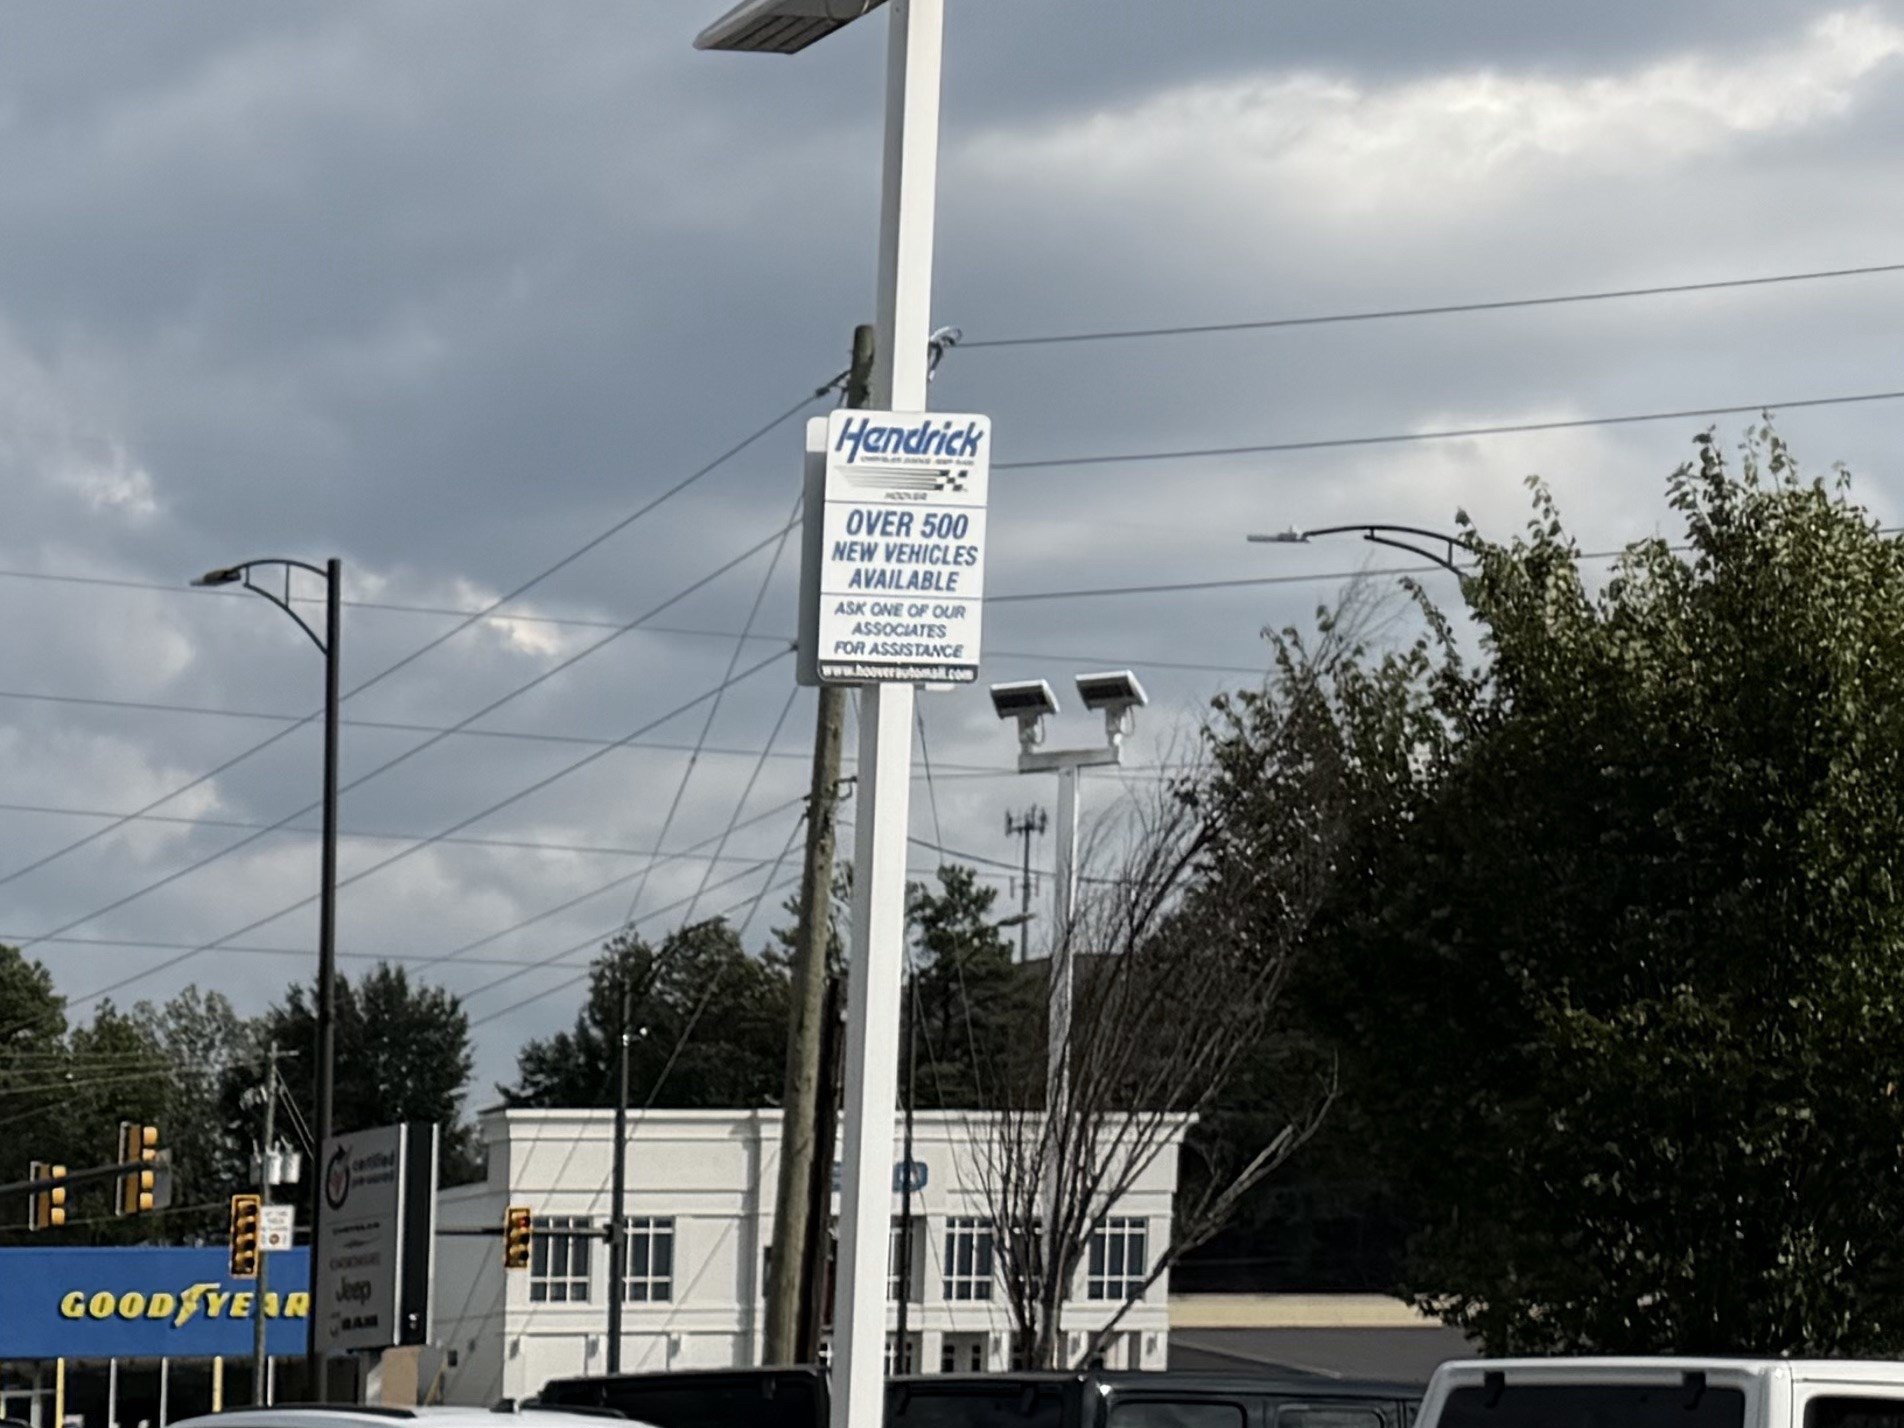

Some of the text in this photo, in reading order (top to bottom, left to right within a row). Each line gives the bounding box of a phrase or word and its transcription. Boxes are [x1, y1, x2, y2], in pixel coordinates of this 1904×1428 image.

[835, 417, 985, 464] Hendrick
[846, 509, 969, 539] OVER 500
[831, 541, 979, 566] NEW VEHICLES
[848, 568, 960, 591] AVAILABLE
[834, 602, 967, 619] ASK ONE OF OUR
[852, 622, 947, 639] ASSOCIATES
[834, 641, 965, 658] FOR ASSISTANCE
[335, 1276, 372, 1306] Jeep
